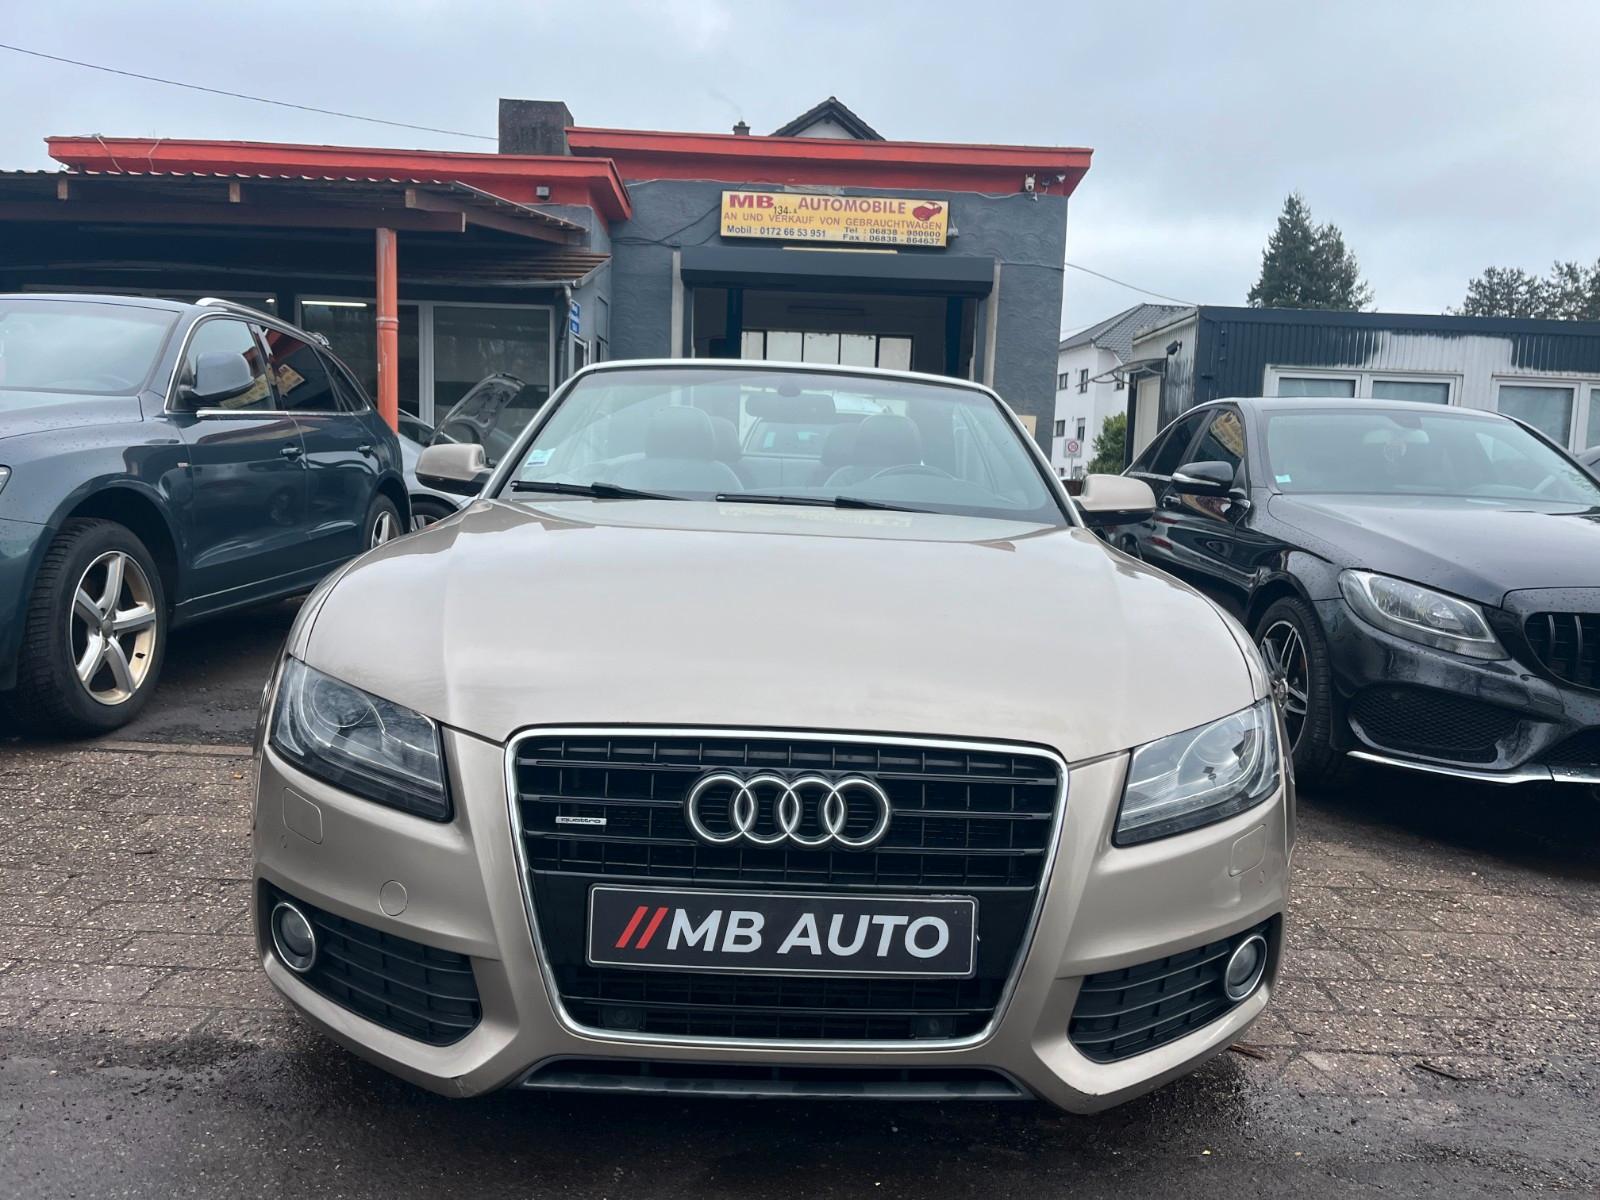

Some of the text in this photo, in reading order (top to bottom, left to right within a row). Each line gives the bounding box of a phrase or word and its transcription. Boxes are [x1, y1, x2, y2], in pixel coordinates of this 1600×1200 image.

[729, 194, 906, 214] MB AUTOMOBILE
[724, 212, 942, 230] AN UND VERKAUF VON GEBRAUCHTWAGEN
[727, 225, 751, 234] Mobil
[760, 227, 781, 236] 0172
[776, 912, 950, 959] AUTO
